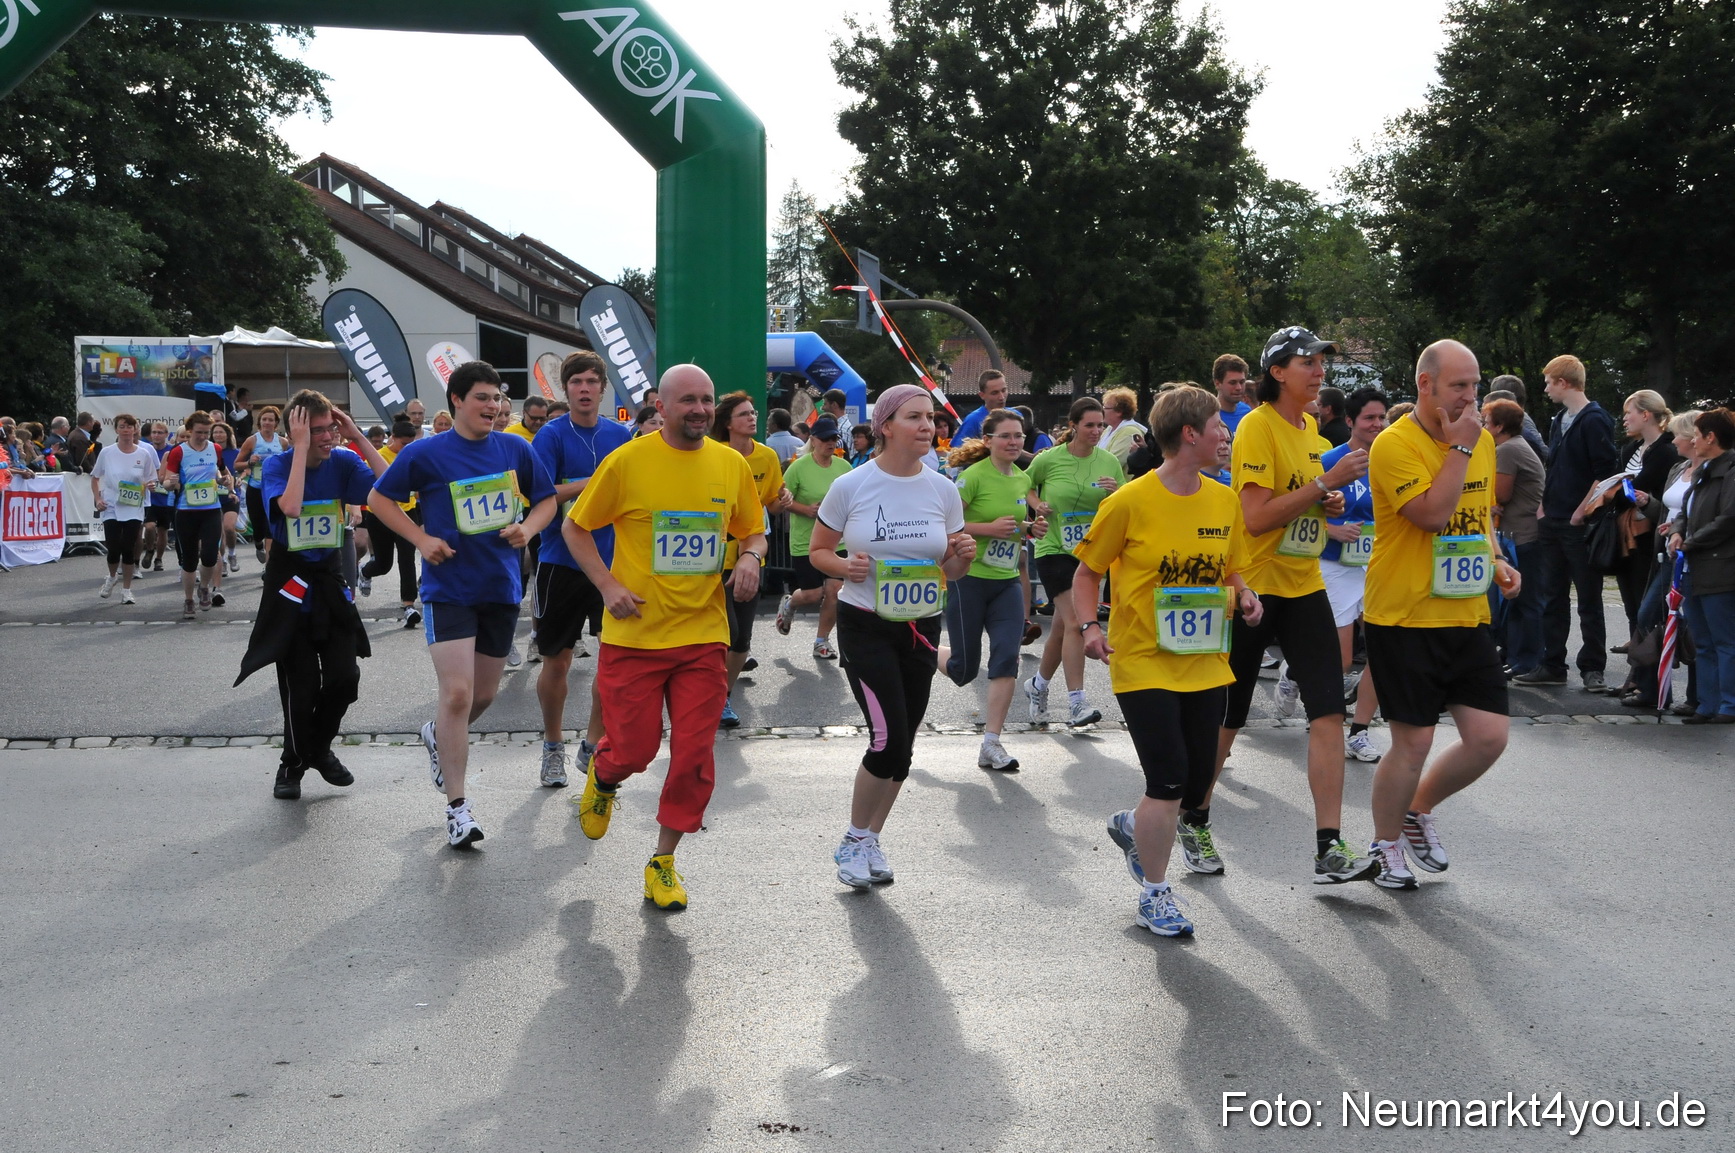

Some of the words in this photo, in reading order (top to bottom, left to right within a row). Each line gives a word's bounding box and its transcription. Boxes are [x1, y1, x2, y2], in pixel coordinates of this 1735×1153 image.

[557, 7, 722, 144] AOK
[87, 358, 135, 374] TLA
[142, 365, 200, 381] Logistics
[119, 488, 140, 501] 1205
[194, 488, 208, 500] 13
[463, 492, 508, 519] 114
[7, 497, 58, 537] MEIER
[293, 516, 331, 537] 113
[887, 520, 929, 529] EVANGELISCH
[888, 532, 927, 541] NEUMARKT
[1198, 527, 1221, 536] swn
[1290, 518, 1319, 543] 189
[657, 534, 716, 557] 1291
[988, 540, 1015, 560] 364
[1441, 556, 1484, 582] 186
[880, 582, 938, 605] 1006
[1164, 610, 1212, 637] 181
